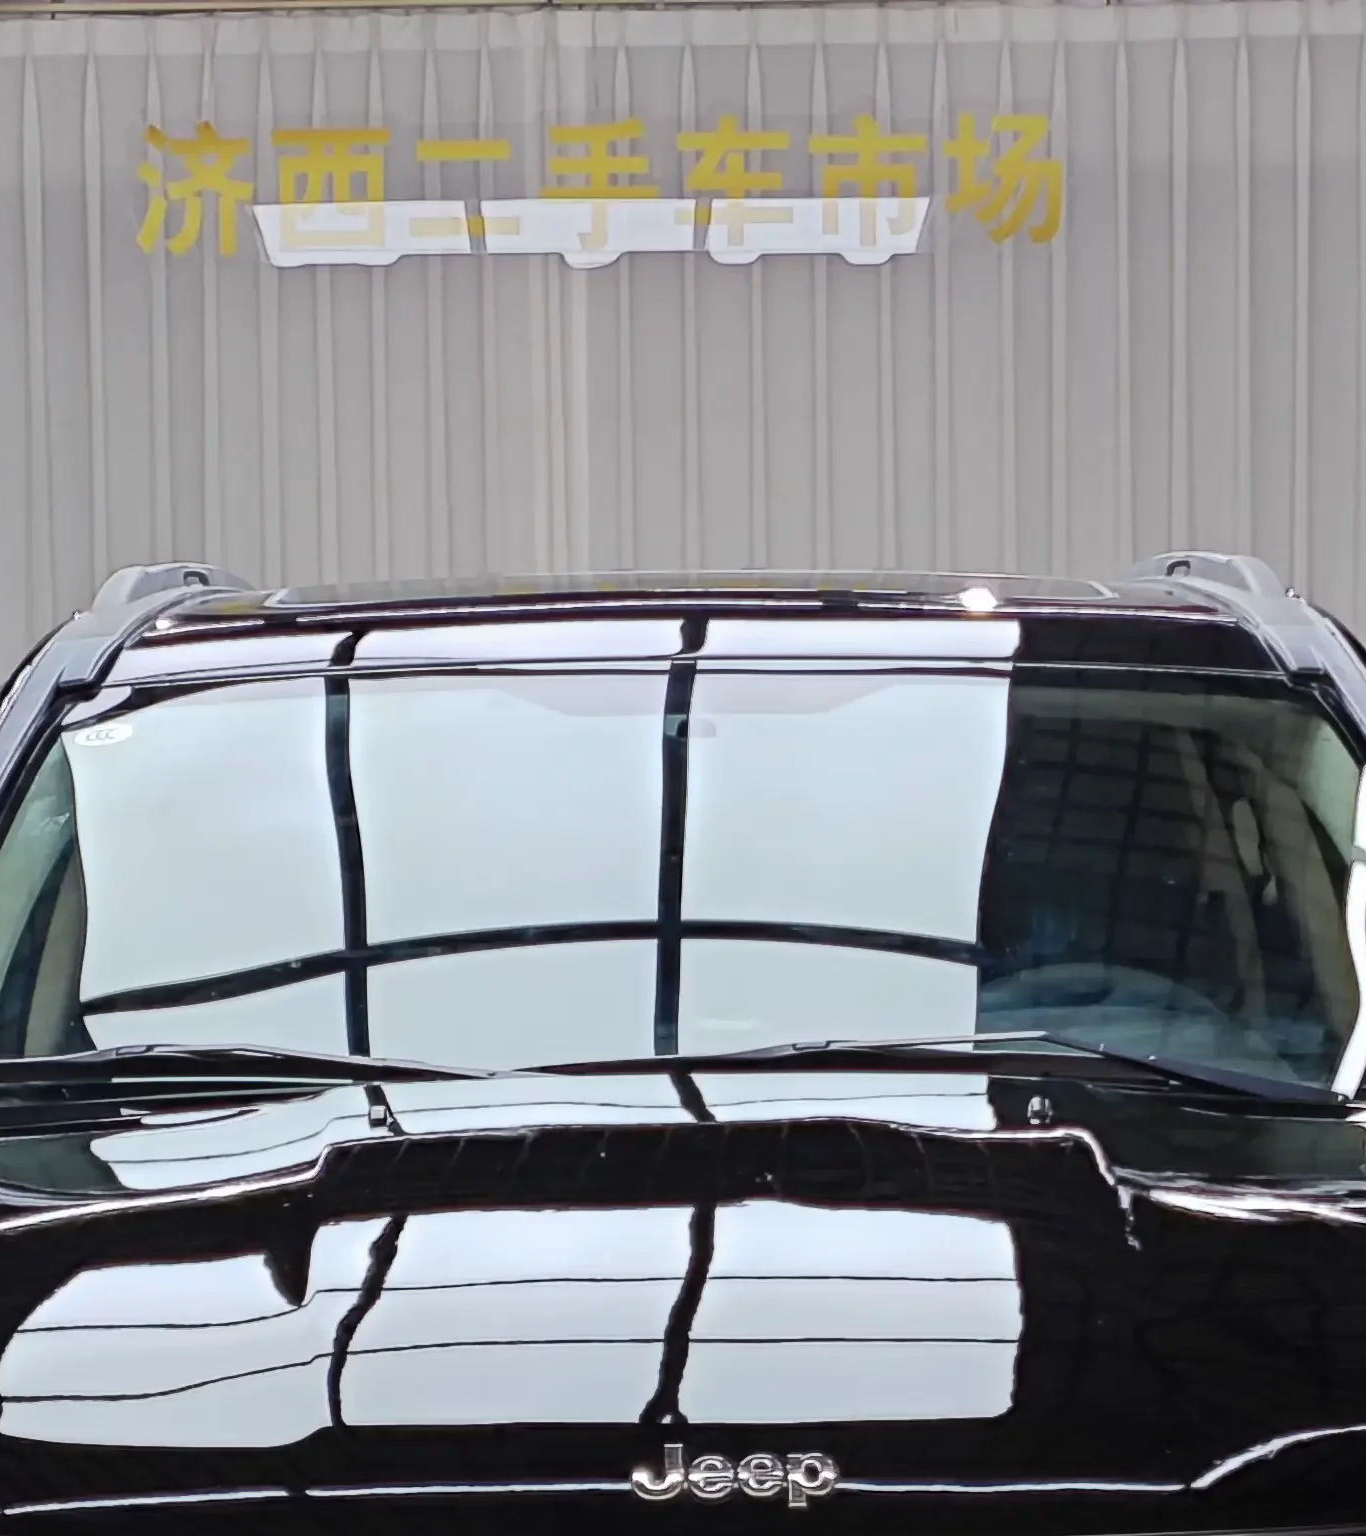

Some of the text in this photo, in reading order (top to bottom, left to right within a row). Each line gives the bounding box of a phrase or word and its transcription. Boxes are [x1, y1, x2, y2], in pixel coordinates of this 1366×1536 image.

[136, 111, 1065, 255] 济西二手车市场
[631, 1443, 838, 1508] Jeep
